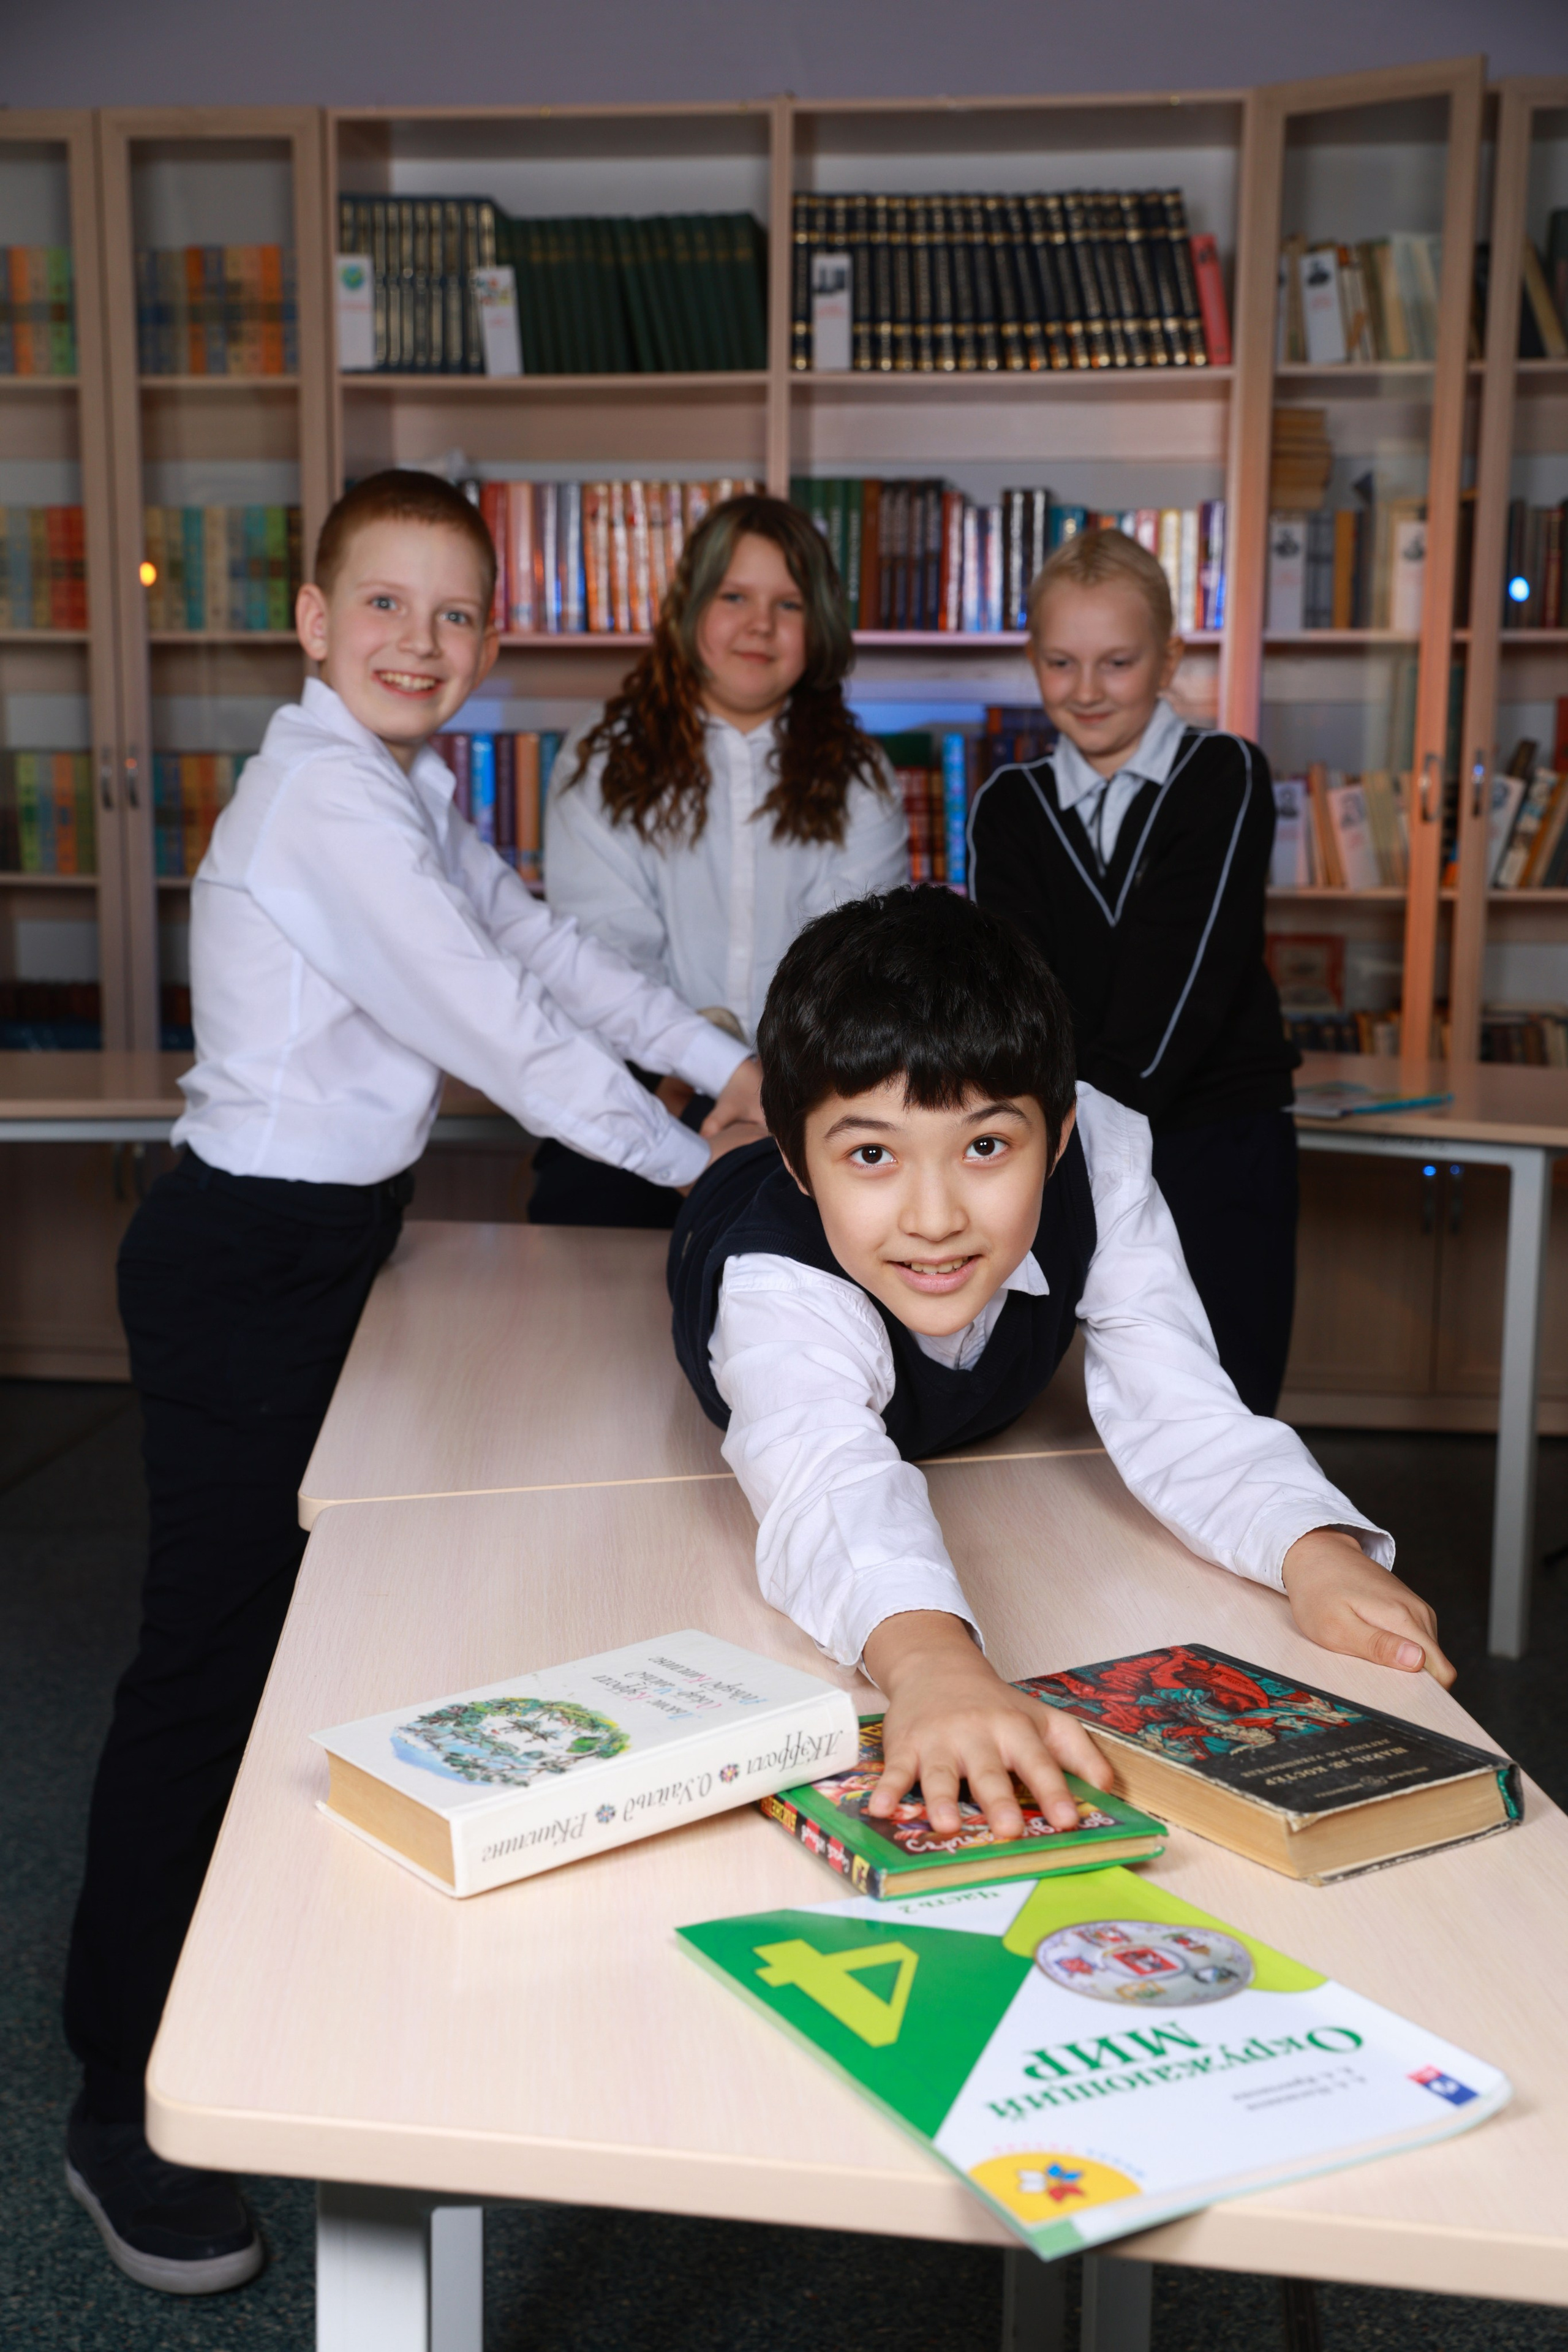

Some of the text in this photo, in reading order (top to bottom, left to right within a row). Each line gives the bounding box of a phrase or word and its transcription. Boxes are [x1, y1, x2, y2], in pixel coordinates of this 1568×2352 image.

[745, 1730, 843, 1776] Л.Кэрролл
[623, 1772, 712, 1822] О.Уайльд
[481, 1811, 589, 1863] Р.Киплинг
[752, 1938, 919, 2048] 4
[985, 2026, 1364, 2122] Окружающий
[1022, 2020, 1211, 2082] МИР
